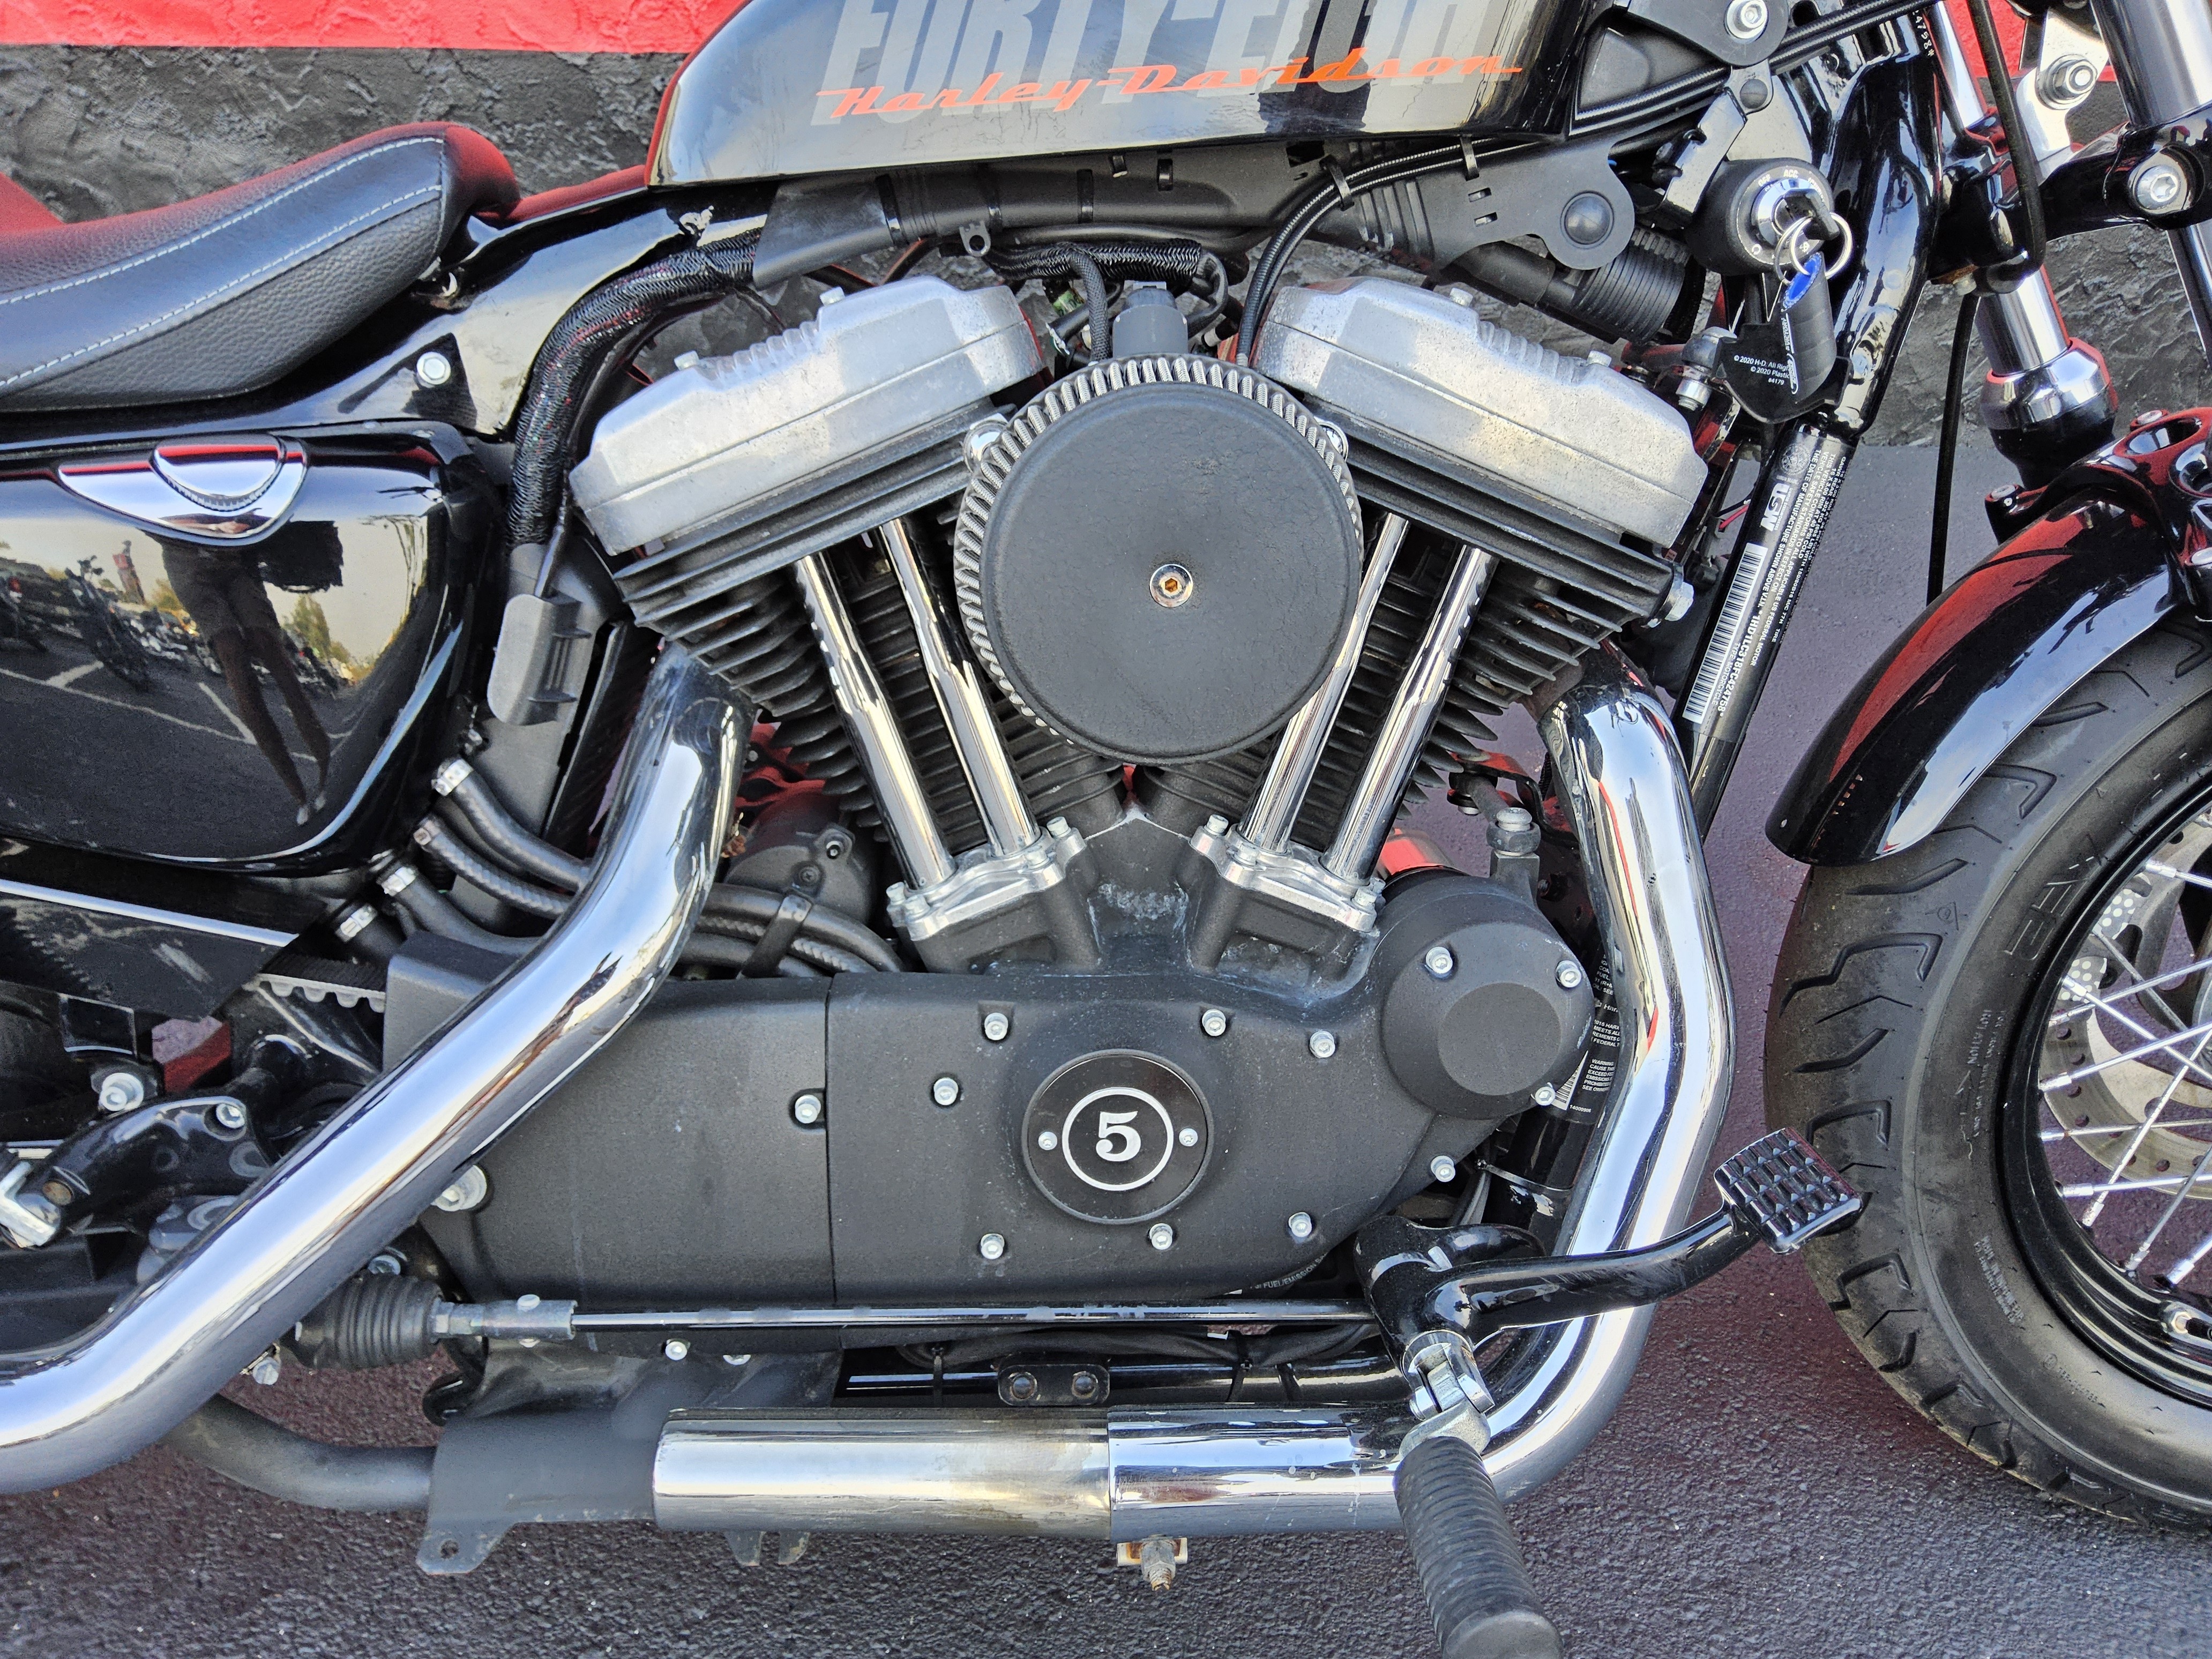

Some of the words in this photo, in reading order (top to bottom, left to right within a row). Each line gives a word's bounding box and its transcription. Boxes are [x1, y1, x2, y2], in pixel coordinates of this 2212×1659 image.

[816, 47, 1522, 118] Harley-Davidson
[1739, 356, 1754, 364] 2020
[1756, 367, 1770, 375] 2020
[1811, 448, 1822, 464] THE
[1813, 450, 1829, 481] VEHICLE
[1825, 452, 1836, 469] THIS
[1804, 462, 1816, 482] DATE
[1829, 467, 1836, 476] 16
[1835, 456, 1846, 477] GAWR
[1800, 481, 1809, 492] OF
[1803, 480, 1818, 506] SAFETY
[1814, 468, 1830, 498] VEHICLE
[1821, 481, 1831, 496] 3.00
[1827, 477, 1838, 497] REAR
[1817, 495, 1826, 509] RIM
[1780, 491, 1805, 543] MANUFACTURE
[1799, 498, 1818, 537] CONFORMS
[1813, 509, 1820, 519] AT
[1817, 512, 1825, 524] KG
[1788, 506, 1808, 548] STANDARDS
[1805, 527, 1813, 539] PSI
[1795, 536, 1804, 547] TO
[1797, 539, 1809, 559] COLD
[1771, 542, 1785, 569] SHOWN
[1790, 547, 1799, 561] ALL
[1800, 549, 1810, 567] WITH
[1774, 555, 1789, 581] EFFECT
[1762, 567, 1776, 592] ABOVE
[1770, 581, 1779, 593] ON
[1774, 561, 1794, 602] APPLICABLE
[1770, 601, 1778, 611] US
[1759, 611, 1775, 642] FEDERAL
[1771, 627, 1780, 643] TIRE
[1749, 641, 1763, 667] MOTOR
[1711, 660, 1733, 706] MOTORCYCLE
[1593, 1025, 1611, 1035] MEETS
[1593, 1038, 1616, 1047] FEDERAL
[1096, 1111, 1141, 1162] 5
[1263, 1263, 1317, 1289] FUEL/EMISSION
